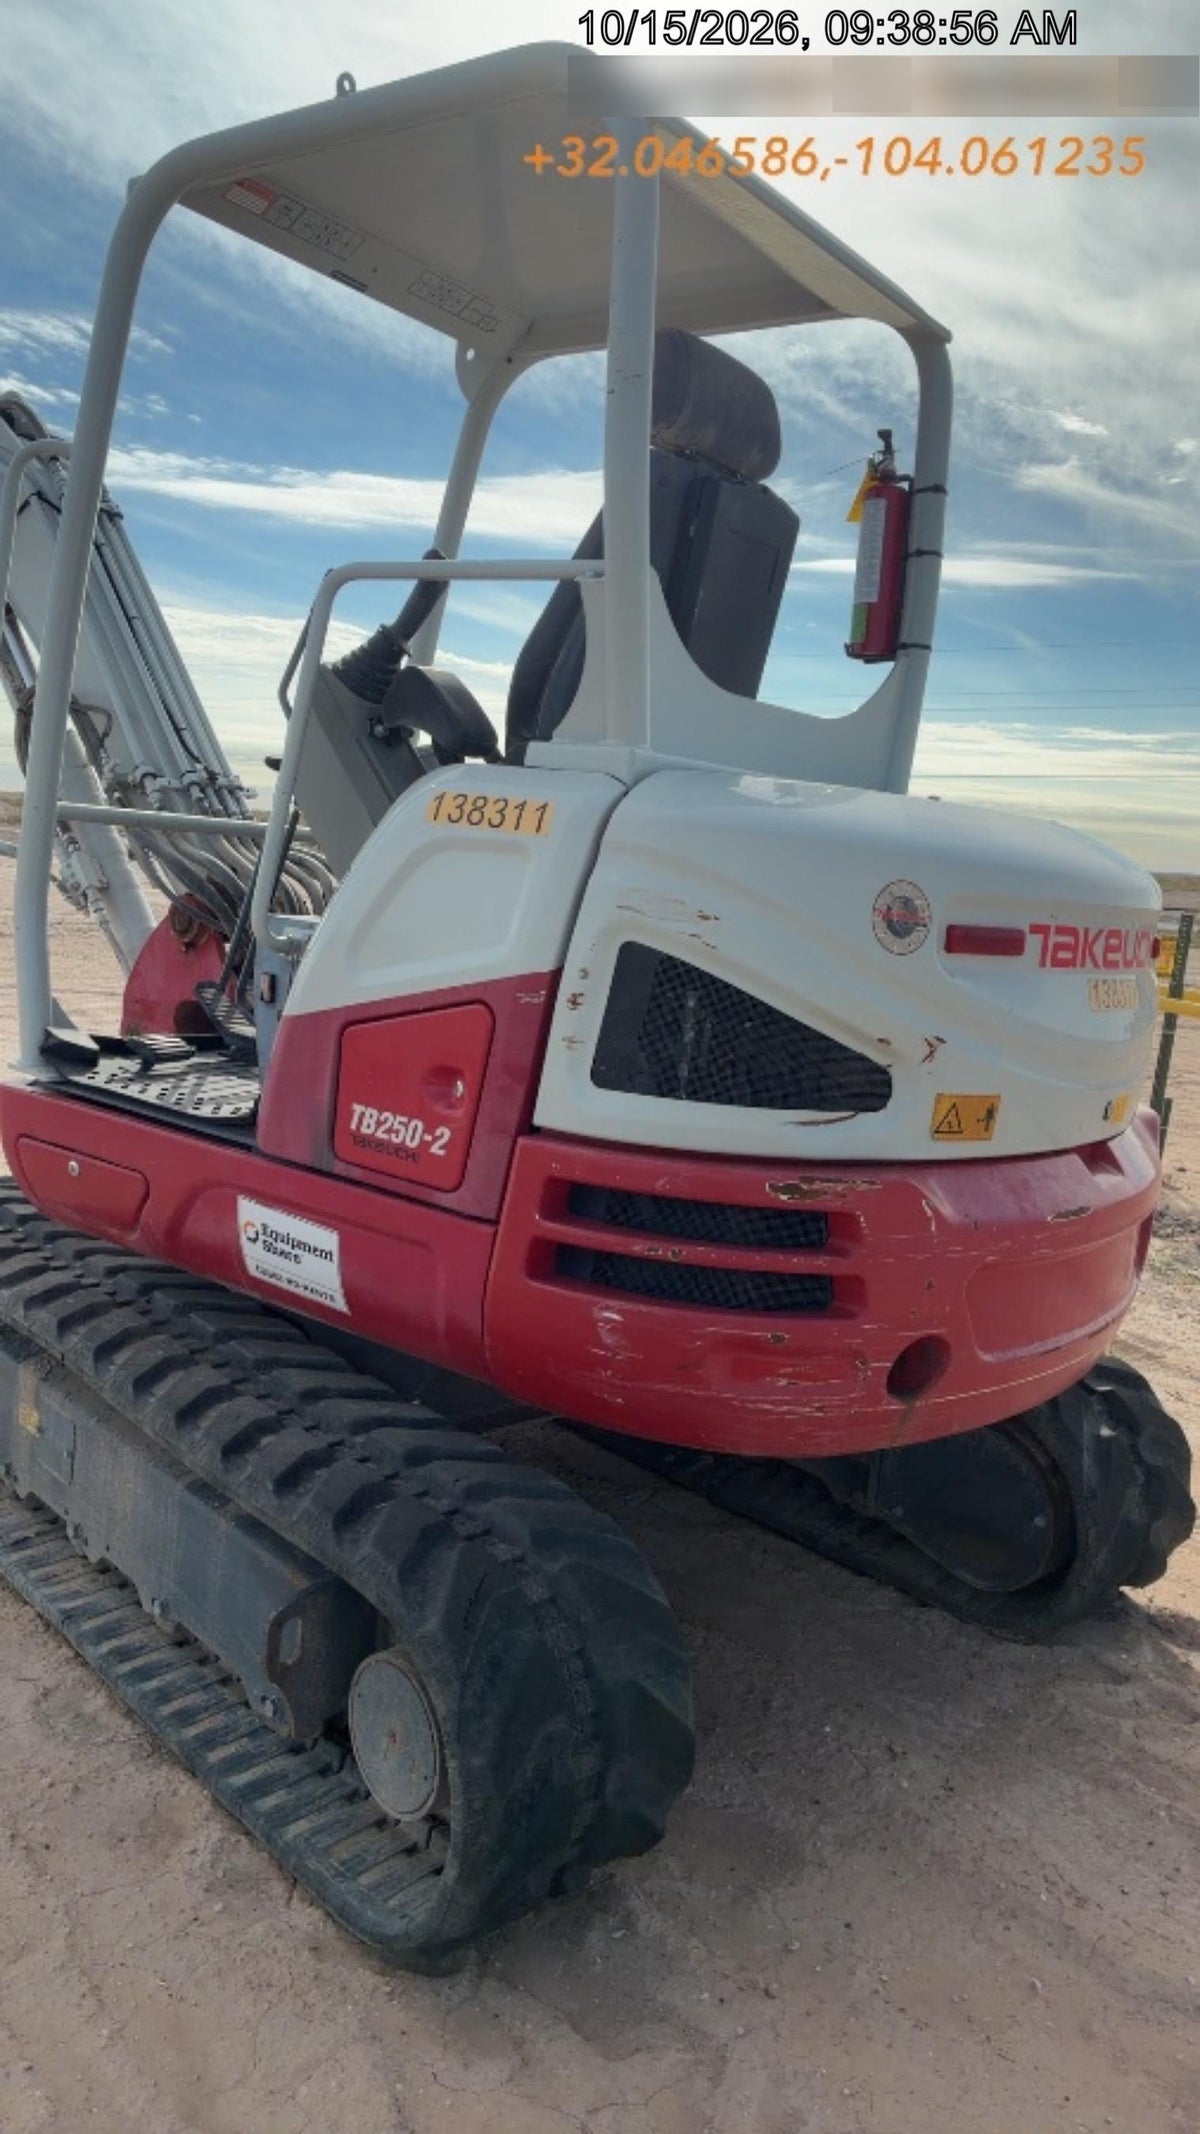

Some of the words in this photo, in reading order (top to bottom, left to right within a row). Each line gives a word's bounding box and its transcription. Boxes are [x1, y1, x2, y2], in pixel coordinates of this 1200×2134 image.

[432, 791, 549, 834] 138311
[350, 1102, 451, 1156] TB250-2
[260, 1222, 334, 1263] Equipment
